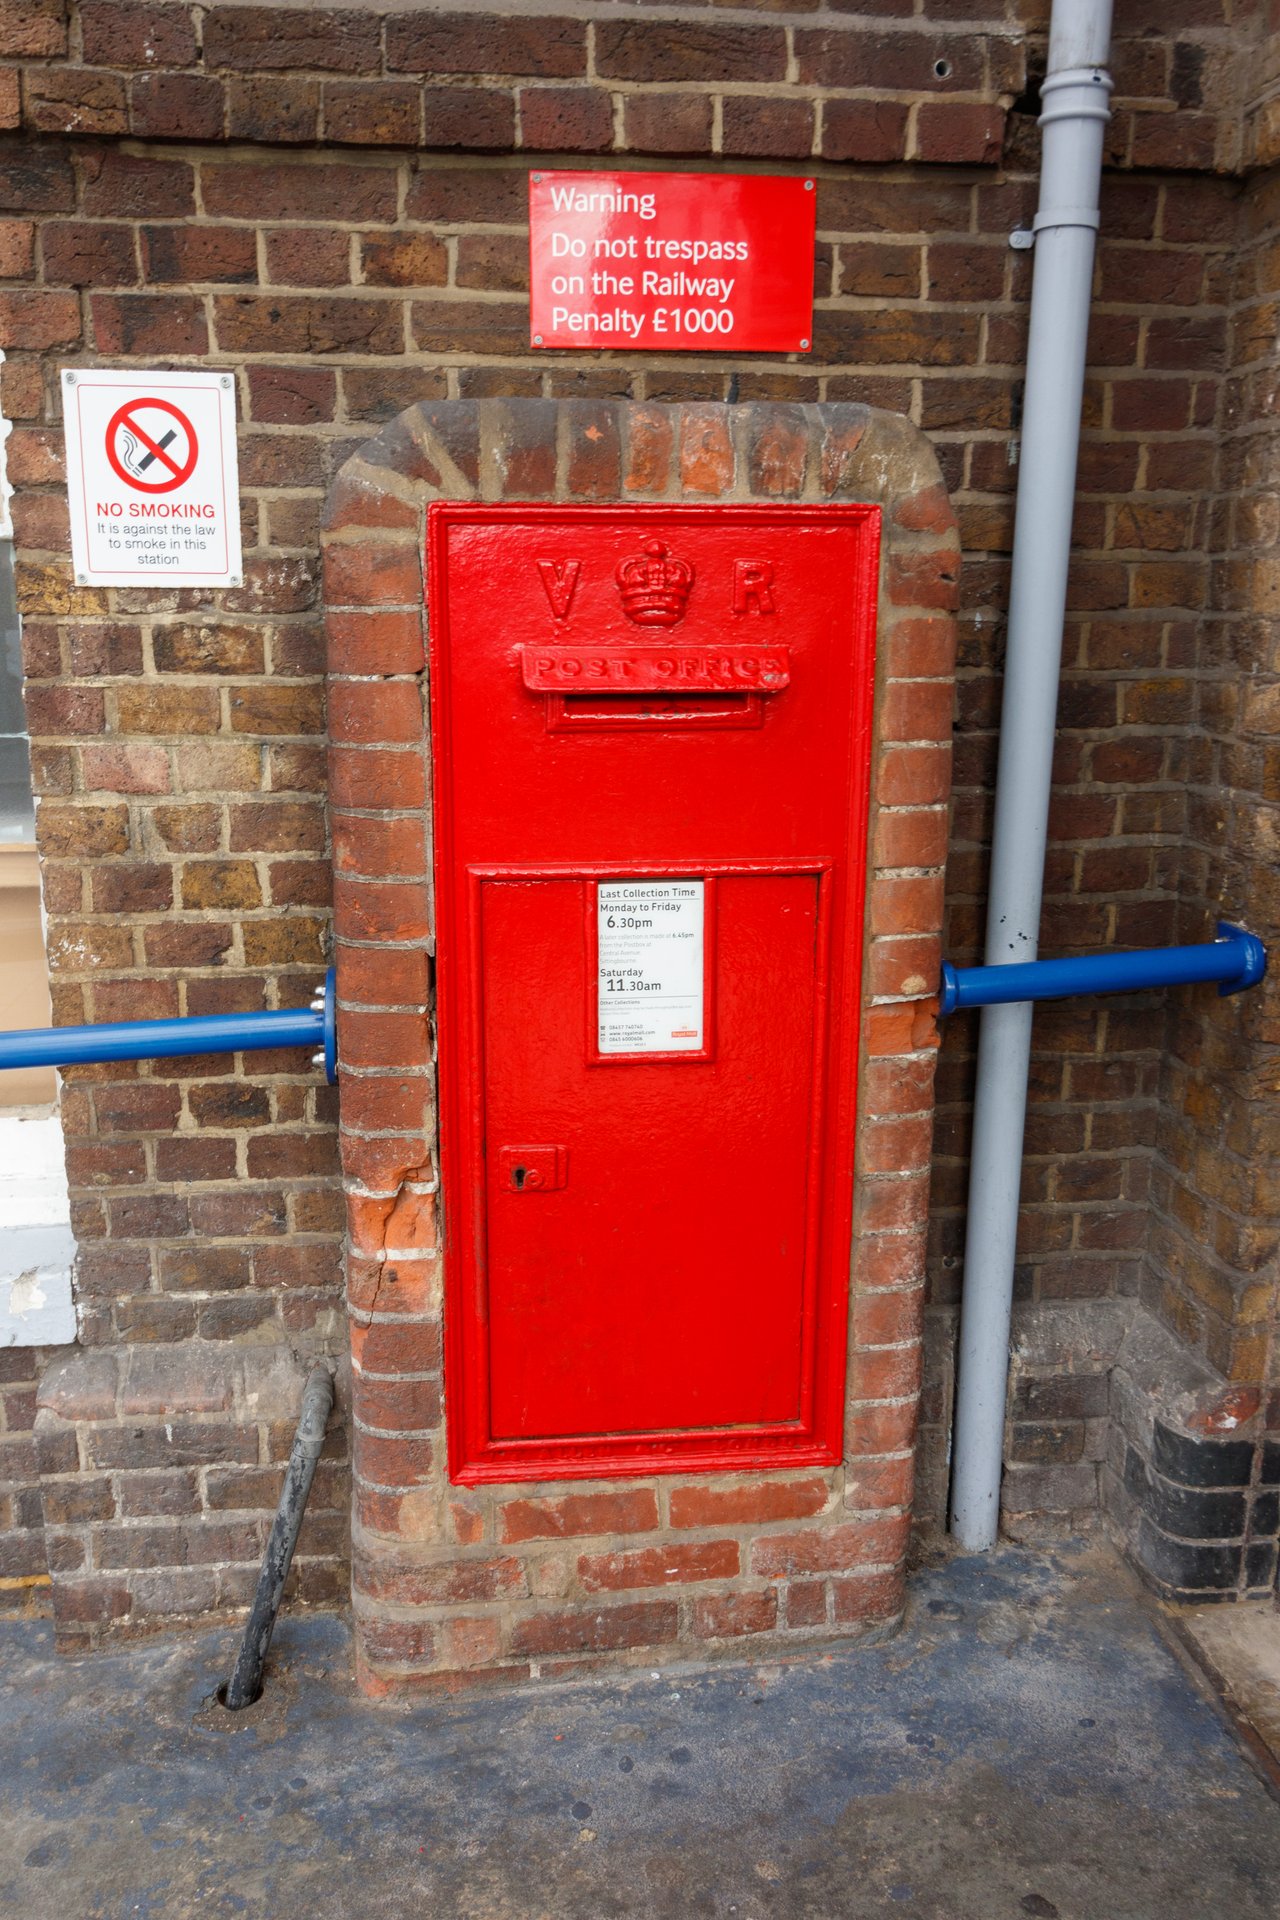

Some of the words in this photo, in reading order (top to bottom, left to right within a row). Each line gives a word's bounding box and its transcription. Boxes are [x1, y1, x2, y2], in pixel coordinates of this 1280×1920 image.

[551, 187, 656, 220] Warning
[551, 233, 586, 257] Do
[595, 235, 638, 258] not
[644, 236, 748, 264] trespass
[551, 275, 584, 294] on
[592, 270, 634, 295] the
[642, 271, 734, 303] Railway
[552, 307, 645, 338] Penalty
[652, 308, 734, 333] £1000
[96, 502, 123, 517] NO
[129, 502, 215, 518] SMOKING
[97, 522, 105, 534] It
[110, 522, 119, 534] is
[123, 523, 168, 537] against
[172, 523, 191, 535] the
[195, 523, 216, 536] law
[109, 538, 121, 549] to
[125, 537, 166, 549] smoke
[170, 538, 180, 549] in
[184, 538, 207, 550] this
[138, 553, 180, 565] station
[537, 558, 582, 619] V
[732, 557, 776, 615] R
[533, 656, 633, 680] POST
[600, 889, 621, 899] Last
[623, 888, 670, 898] Collection
[672, 887, 696, 897] Time
[600, 903, 637, 914] Monday
[639, 904, 649, 912] to
[651, 902, 682, 913] Friday
[607, 915, 653, 930] 6.30pm
[600, 968, 644, 977] Saturday
[607, 979, 661, 992] 11.30am
